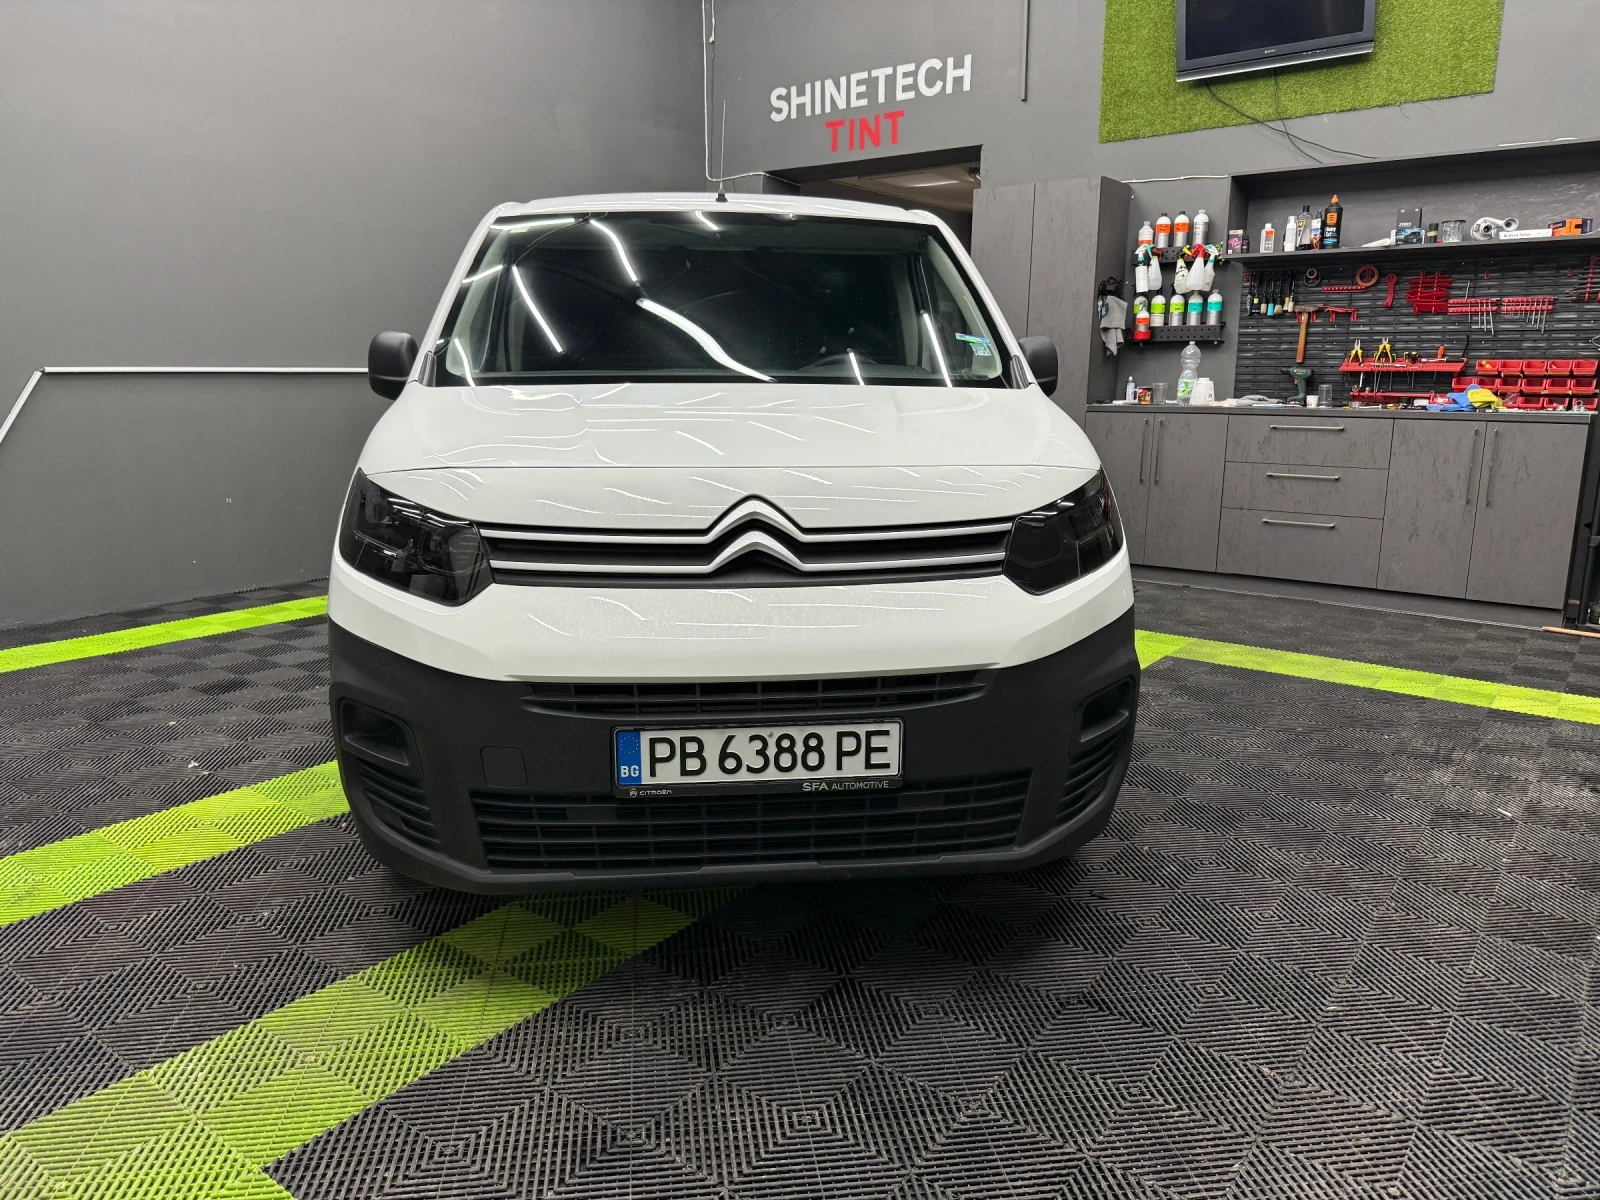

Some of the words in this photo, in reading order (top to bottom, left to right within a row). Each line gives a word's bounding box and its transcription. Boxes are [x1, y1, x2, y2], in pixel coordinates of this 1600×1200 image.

[770, 54, 972, 122] SHINETECH
[825, 109, 905, 152] TINT
[620, 765, 640, 777] BG
[649, 736, 707, 777] PB
[718, 732, 825, 774] 6388
[836, 729, 891, 770] PE
[802, 782, 829, 791] SFA
[831, 780, 889, 790] AUTOMOTIVE
